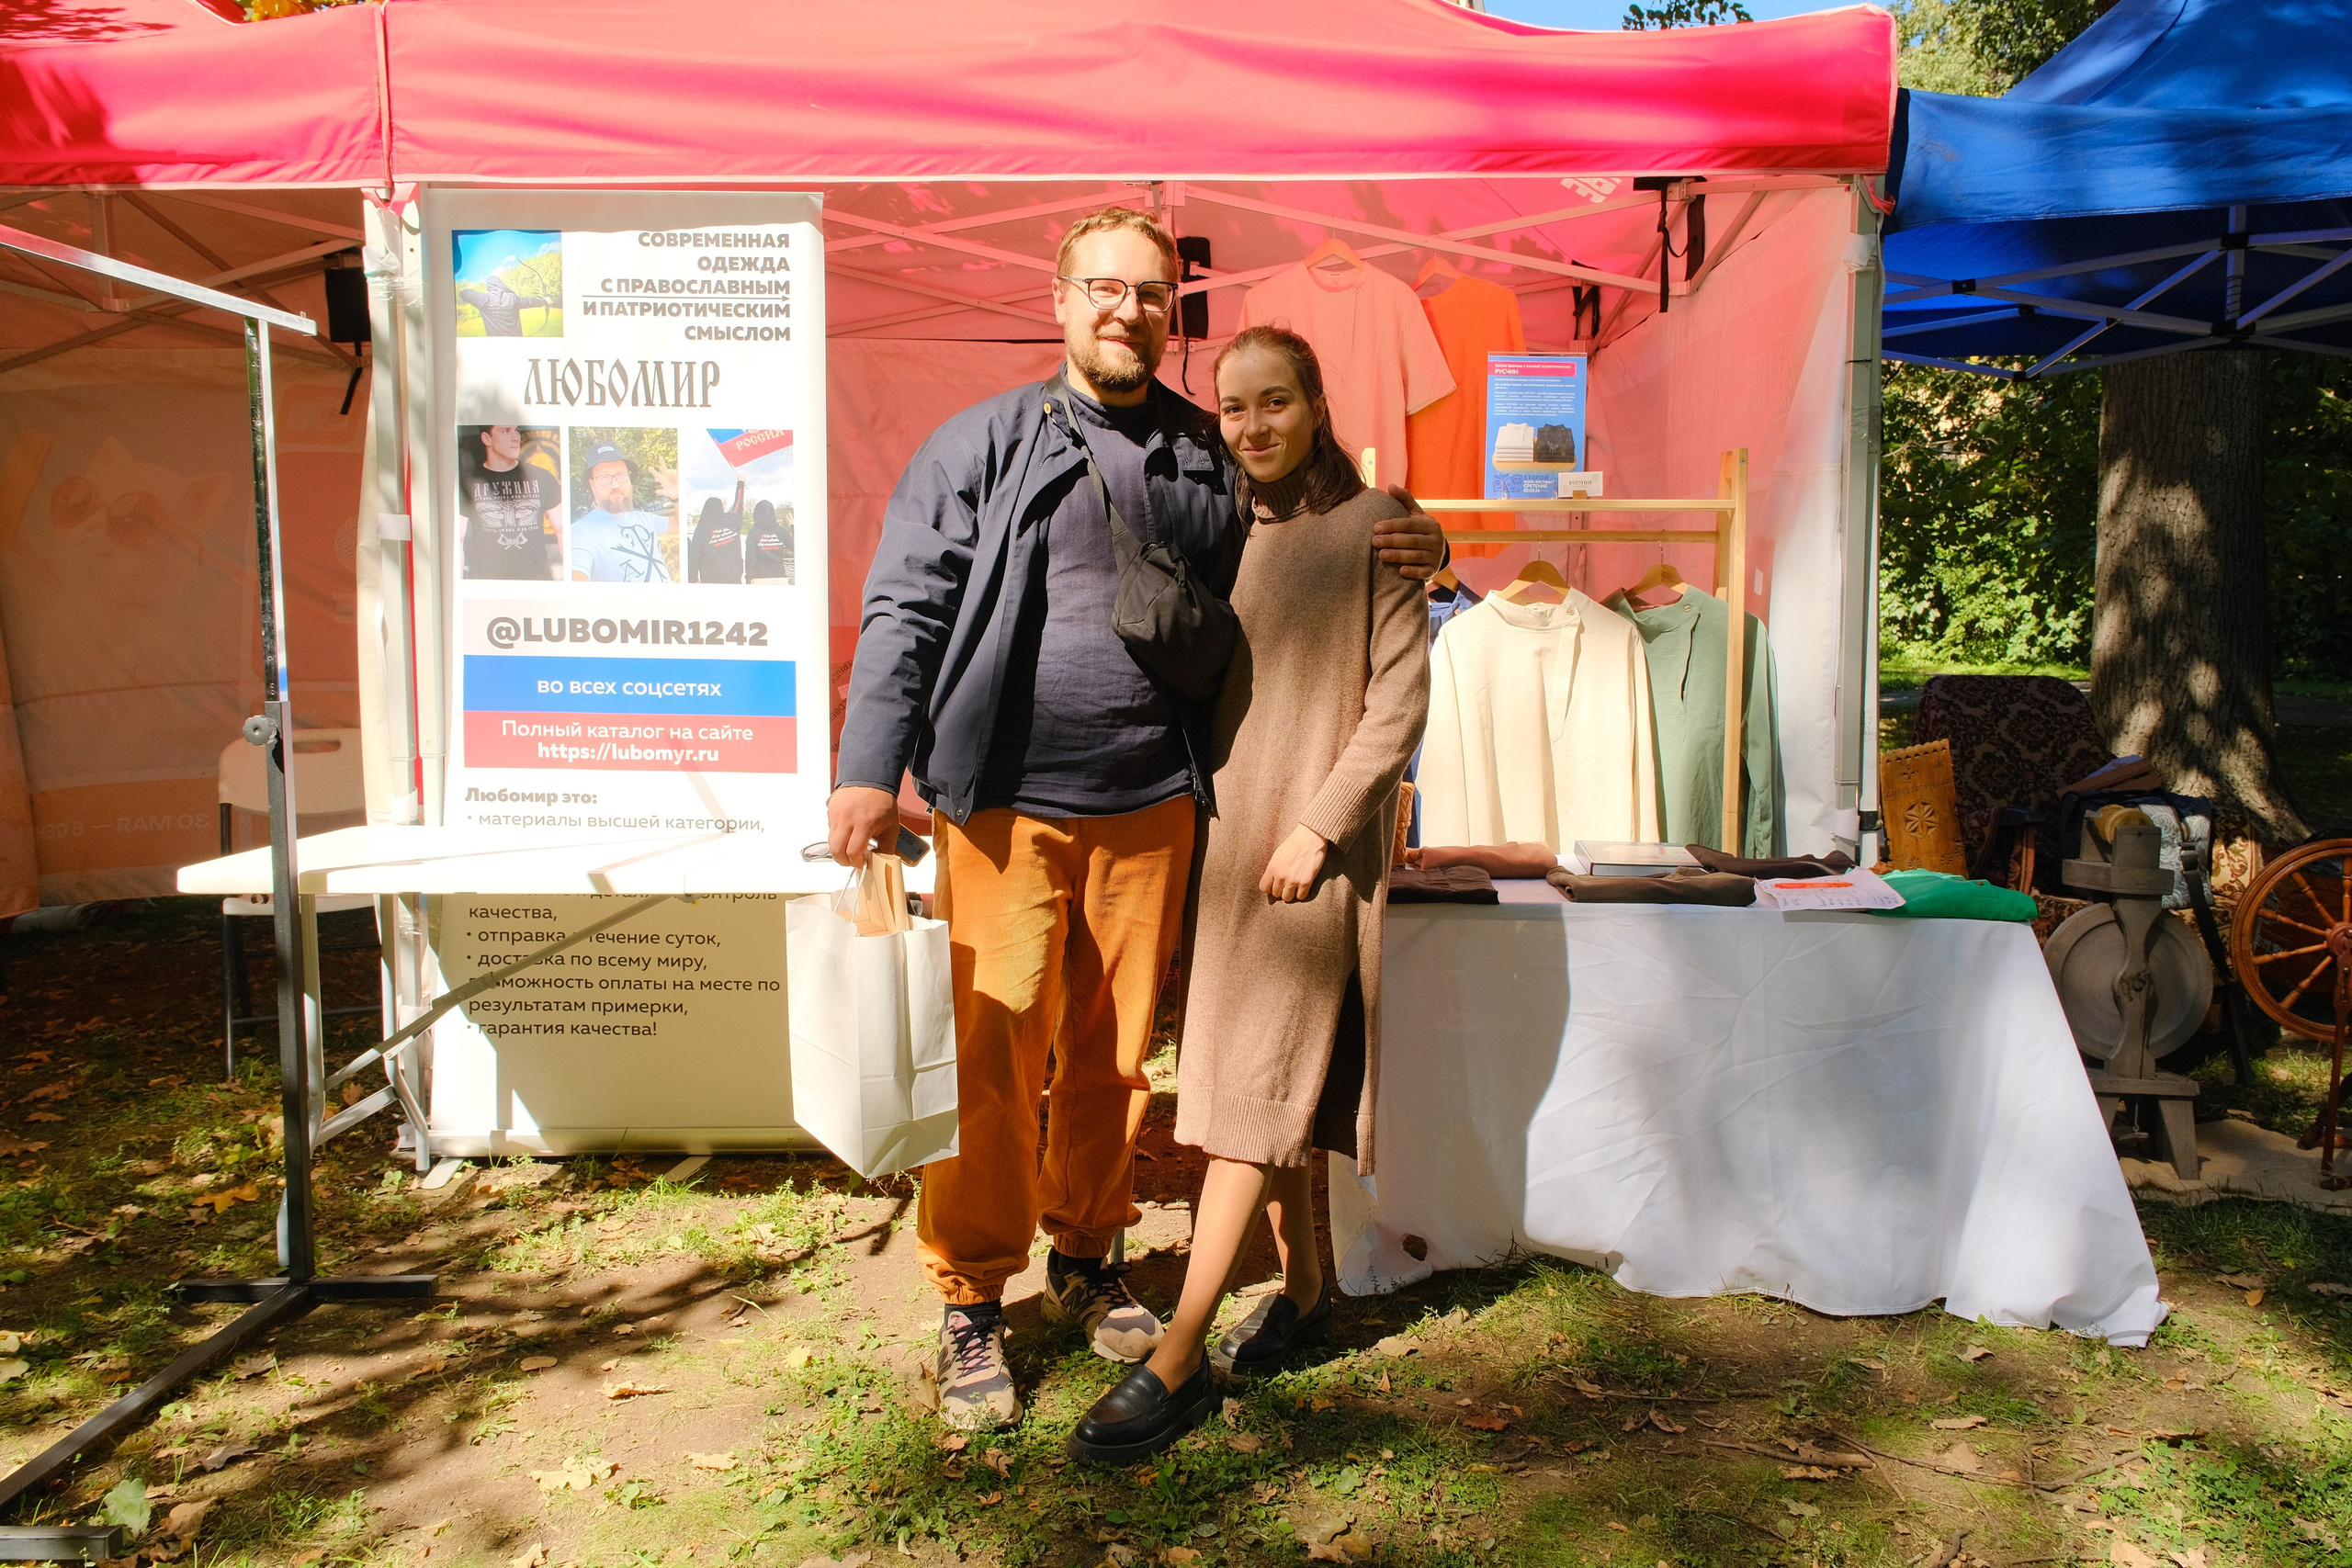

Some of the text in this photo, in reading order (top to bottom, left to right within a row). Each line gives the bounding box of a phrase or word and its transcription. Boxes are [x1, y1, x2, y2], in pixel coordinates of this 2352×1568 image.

[638, 231, 790, 249] СОВРЕМЕННАЯ
[696, 256, 791, 274] ОДЕЖДА
[600, 278, 791, 296] С ПРАВОСЛАВНЫМ
[582, 301, 791, 319] И ПАТРИОТИЧЕСКИМ
[684, 325, 791, 342] СМЫСЛОМ
[524, 357, 721, 408] ЛЮБОМИР
[735, 429, 786, 451] РОССИЯ
[474, 480, 540, 498] ДРУЖИНА
[487, 616, 769, 649] @LUBOMIR1242
[831, 659, 854, 684] ERRIES
[537, 680, 722, 698] во всех соцсетях
[502, 719, 753, 741] Полный каталог на сайте
[537, 742, 719, 764] https://lubomyr.ru
[465, 787, 598, 806] Любомир это:
[478, 814, 765, 833] материалы высшей категории,
[469, 908, 558, 921] качества,
[478, 931, 566, 945] отправка
[665, 933, 721, 949] суток,
[478, 954, 707, 972] достка по всему миру,
[469, 977, 780, 991] можность оплаты на месте по
[469, 1000, 688, 1017] результатам примерки,
[478, 1022, 658, 1039] гарантия качества!
